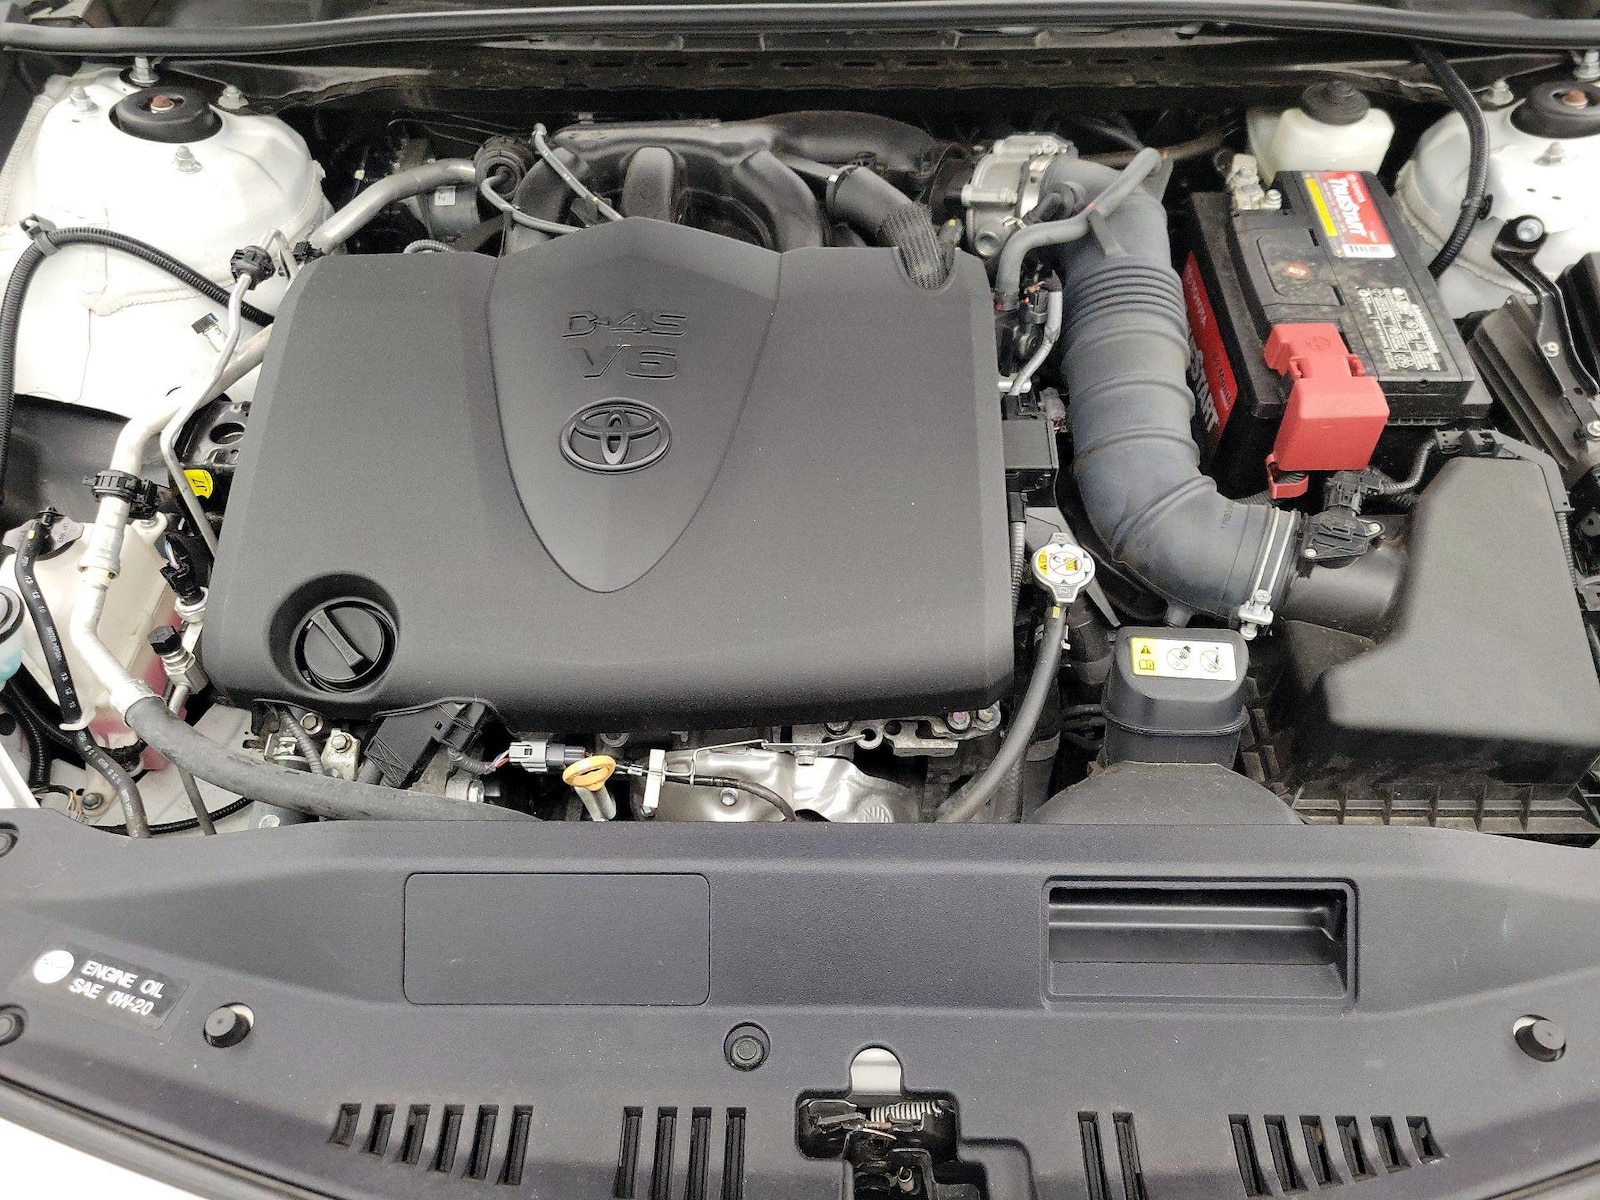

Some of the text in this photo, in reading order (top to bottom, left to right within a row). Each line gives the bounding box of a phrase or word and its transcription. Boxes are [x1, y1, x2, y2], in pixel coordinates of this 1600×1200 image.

[562, 310, 687, 338] D-4S
[568, 346, 678, 379] V6
[69, 977, 105, 1000] SAE
[81, 960, 165, 999] ENGINE OIL
